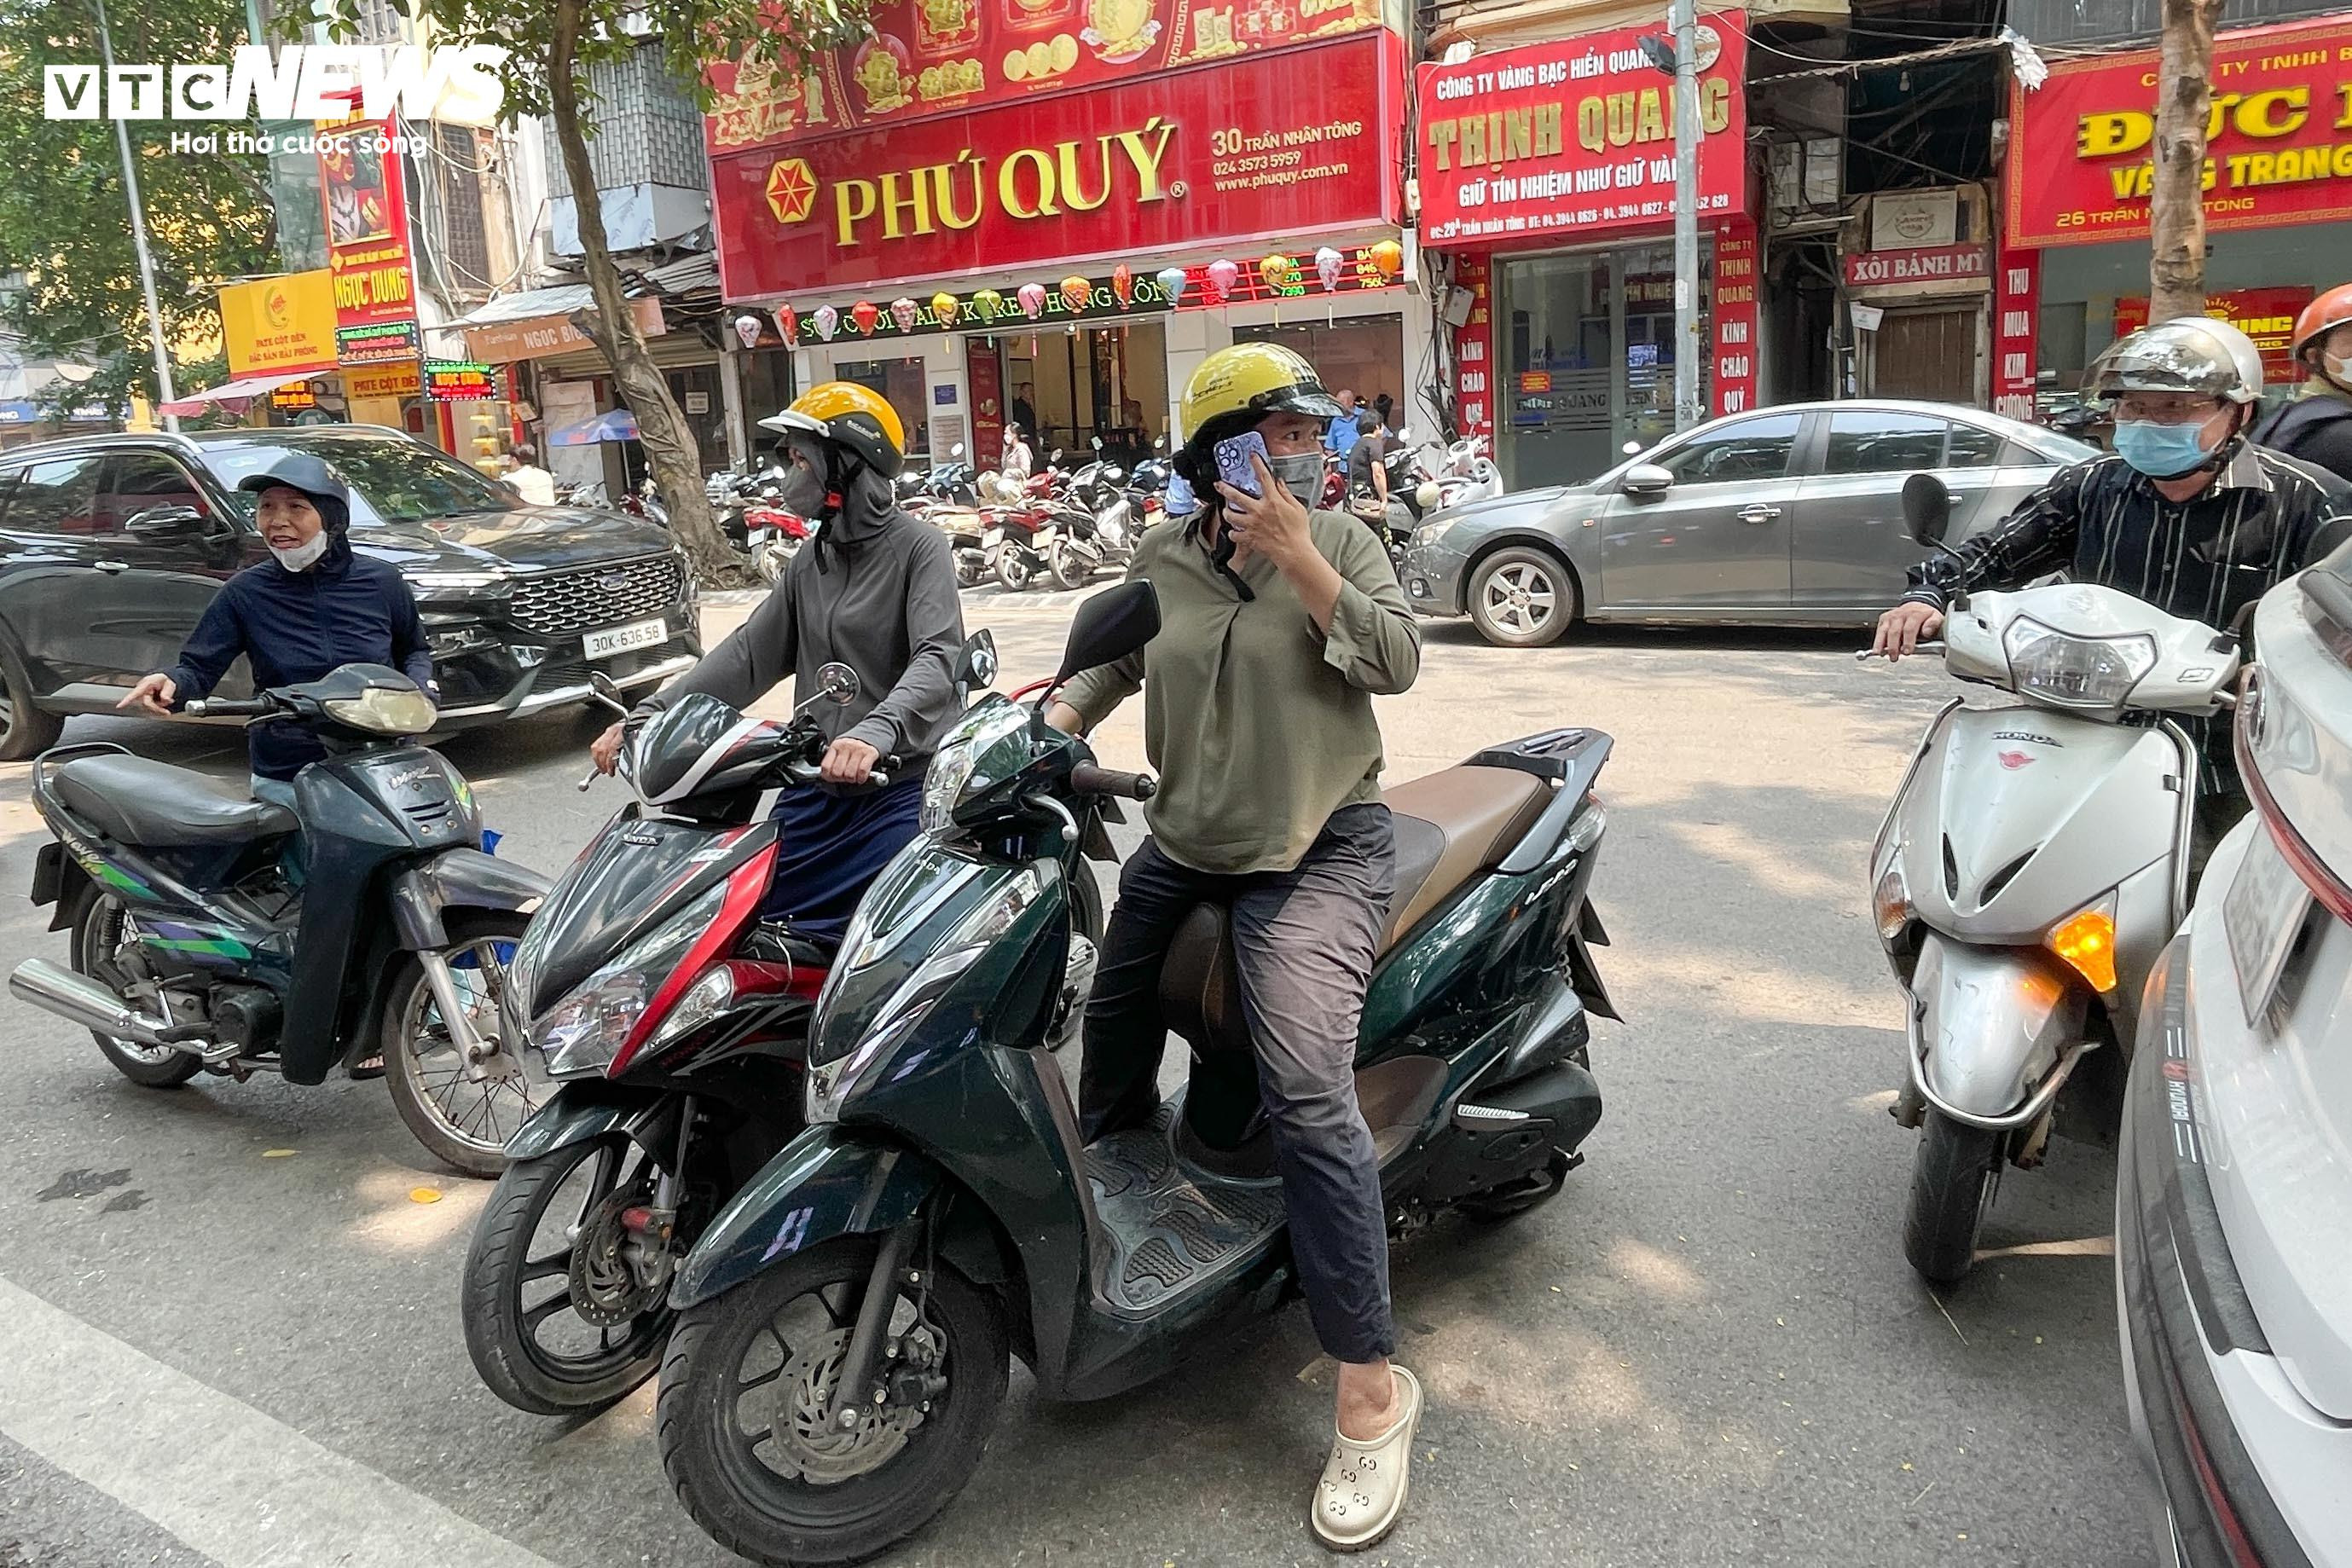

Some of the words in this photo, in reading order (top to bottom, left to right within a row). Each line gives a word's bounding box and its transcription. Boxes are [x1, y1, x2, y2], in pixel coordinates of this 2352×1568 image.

[1437, 76, 1474, 101] CÔNG
[1476, 73, 1494, 95] TY
[1498, 65, 1535, 91] VÀNG
[1538, 61, 1567, 89] BẠC
[1608, 47, 1654, 76] QUAN
[2219, 60, 2250, 77] TY
[2259, 49, 2327, 71] TNHH
[1211, 128, 1243, 157] 30
[1244, 130, 1280, 152] TRẦN
[1283, 125, 1322, 147] NHÂN
[1324, 121, 1363, 141] TÔNG
[1428, 102, 1564, 173] THỊNH
[1214, 160, 1237, 176] 024
[1238, 155, 1268, 173] 3573
[1270, 150, 1302, 169] 5959
[1215, 162, 1349, 192] www.phuquy.com.vn
[833, 148, 985, 247] PHÚ
[998, 116, 1177, 220] QUÝ
[1459, 178, 1487, 207] GIỮ
[1491, 173, 1517, 205] TÍN
[1521, 168, 1573, 203] NHIỆM
[1576, 163, 1613, 194] NHƯ
[1615, 156, 1647, 189] GIỮ
[2056, 211, 2086, 228] 26
[1853, 256, 1889, 281] XÔI
[1894, 252, 1951, 279] BÁNH
[333, 271, 369, 311] NGỌC
[371, 267, 408, 304] DUNG
[1718, 285, 1753, 304] QUANG
[2008, 268, 2030, 295] THU
[1722, 316, 1747, 344] KÍNH
[2003, 310, 2030, 338] MUA
[1461, 338, 1484, 362] KÍNH
[1721, 352, 1748, 379] CHÀO
[2004, 353, 2027, 379] KIM
[354, 379, 377, 391] PATE
[379, 375, 398, 391] CỘT
[1461, 370, 1486, 393] CHÀO
[592, 624, 660, 653] 30K-636.58
